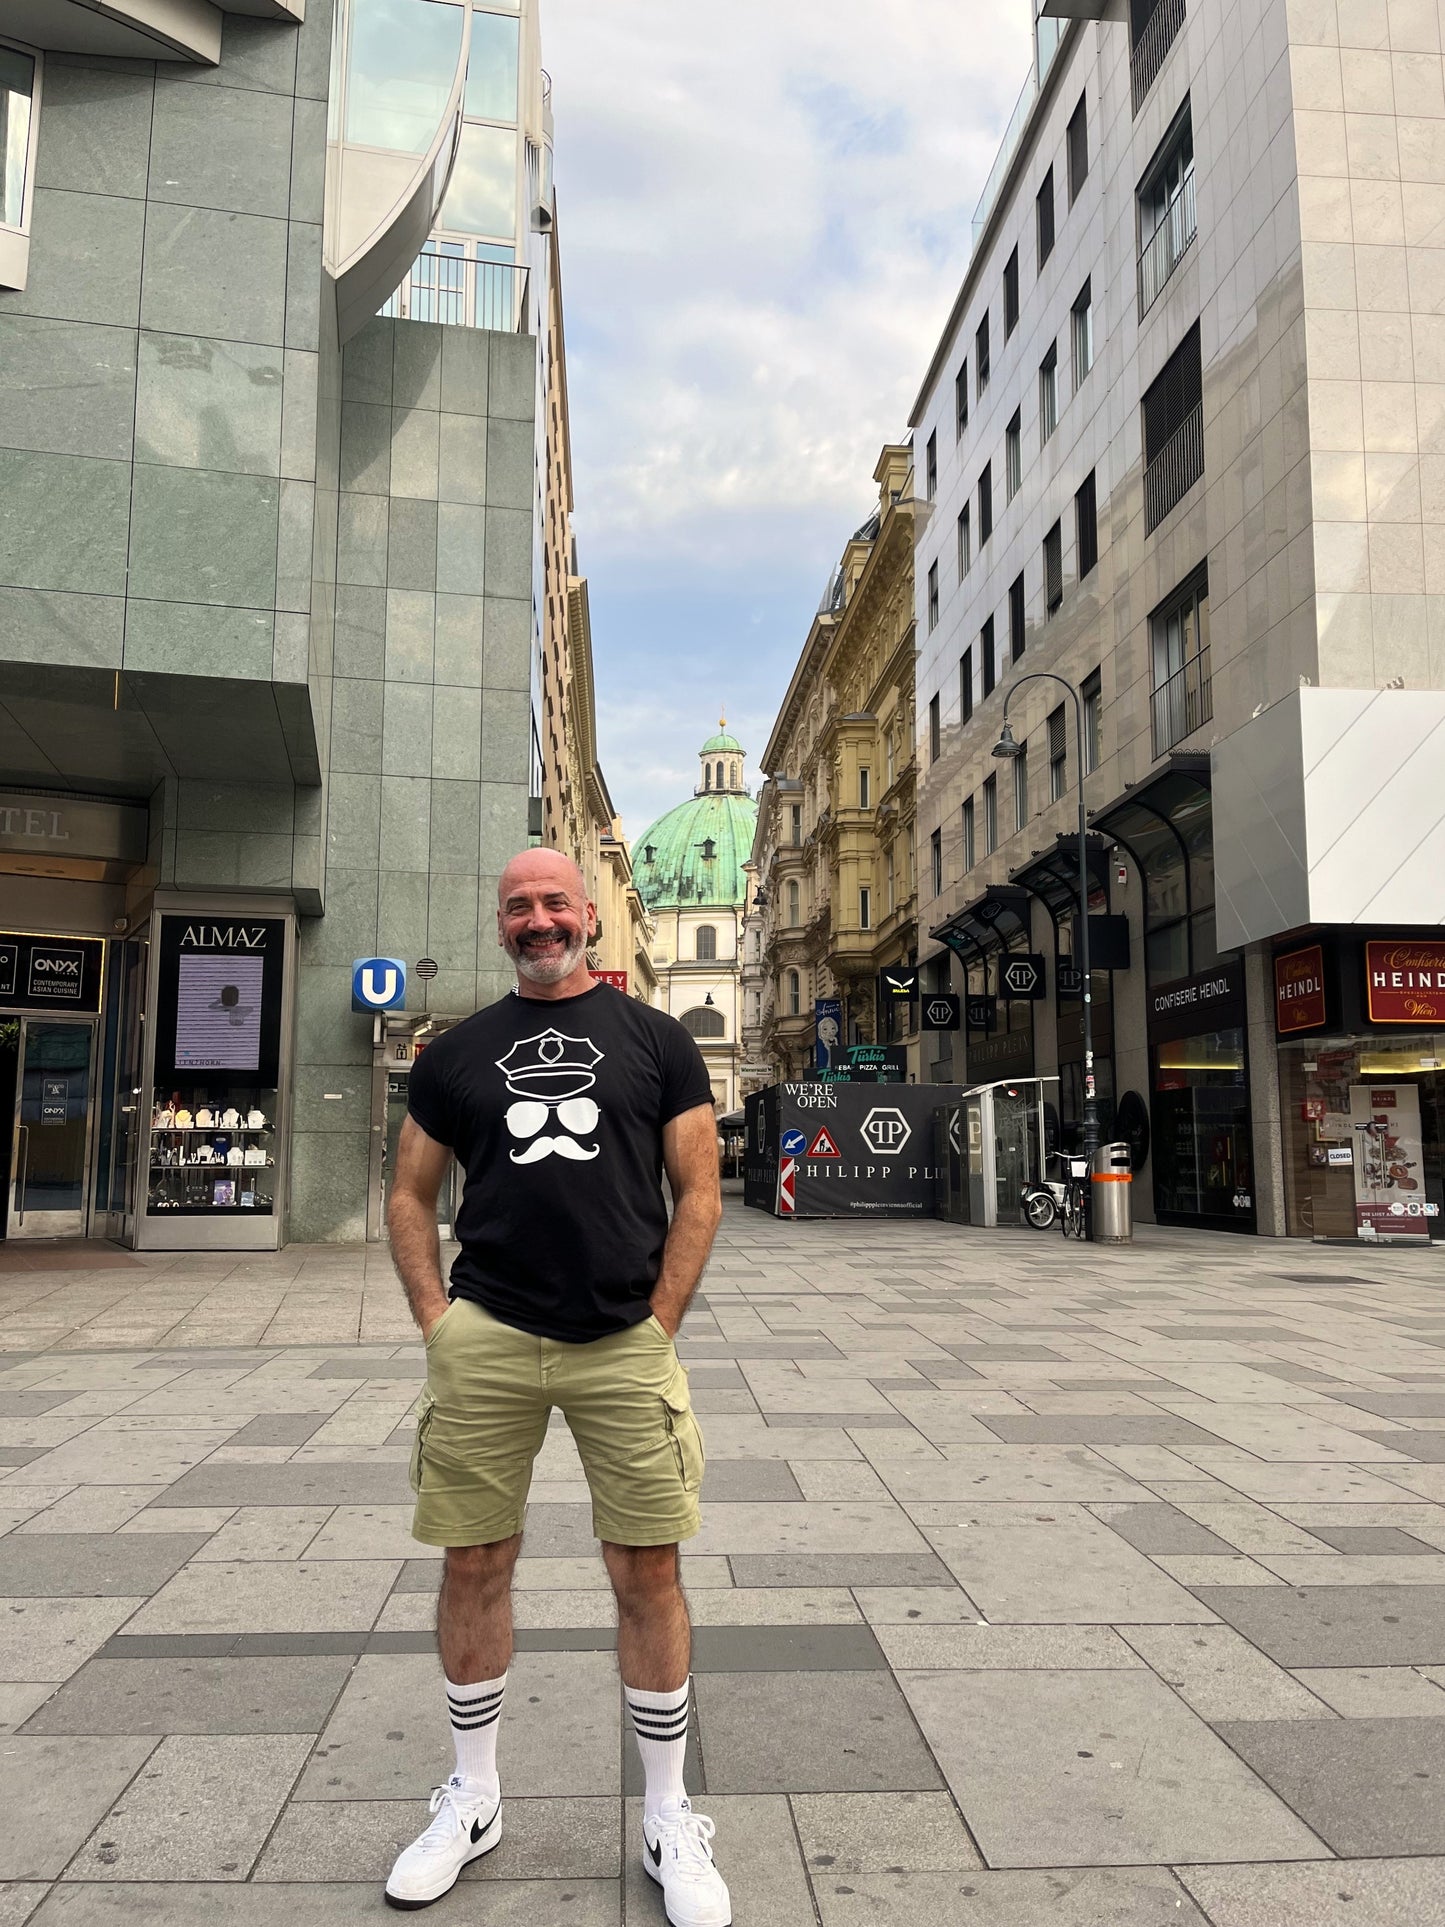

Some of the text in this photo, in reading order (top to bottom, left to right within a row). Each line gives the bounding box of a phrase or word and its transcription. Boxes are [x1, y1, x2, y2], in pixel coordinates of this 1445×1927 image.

[0, 806, 69, 840] TEL
[179, 925, 267, 948] ALMAZ
[34, 958, 79, 973] ONYX
[32, 986, 78, 995] ASIAN CUISINE
[33, 979, 79, 988] CONTEMPORARY
[362, 968, 397, 1005] U
[1279, 976, 1321, 1001] HEINDL
[1154, 977, 1231, 1012] CONFISERIE HEINDL
[1404, 999, 1437, 1017] Wien
[797, 1095, 838, 1108] OPEN
[43, 1107, 65, 1115] ONYX
[794, 1164, 892, 1179] PHILIPP
